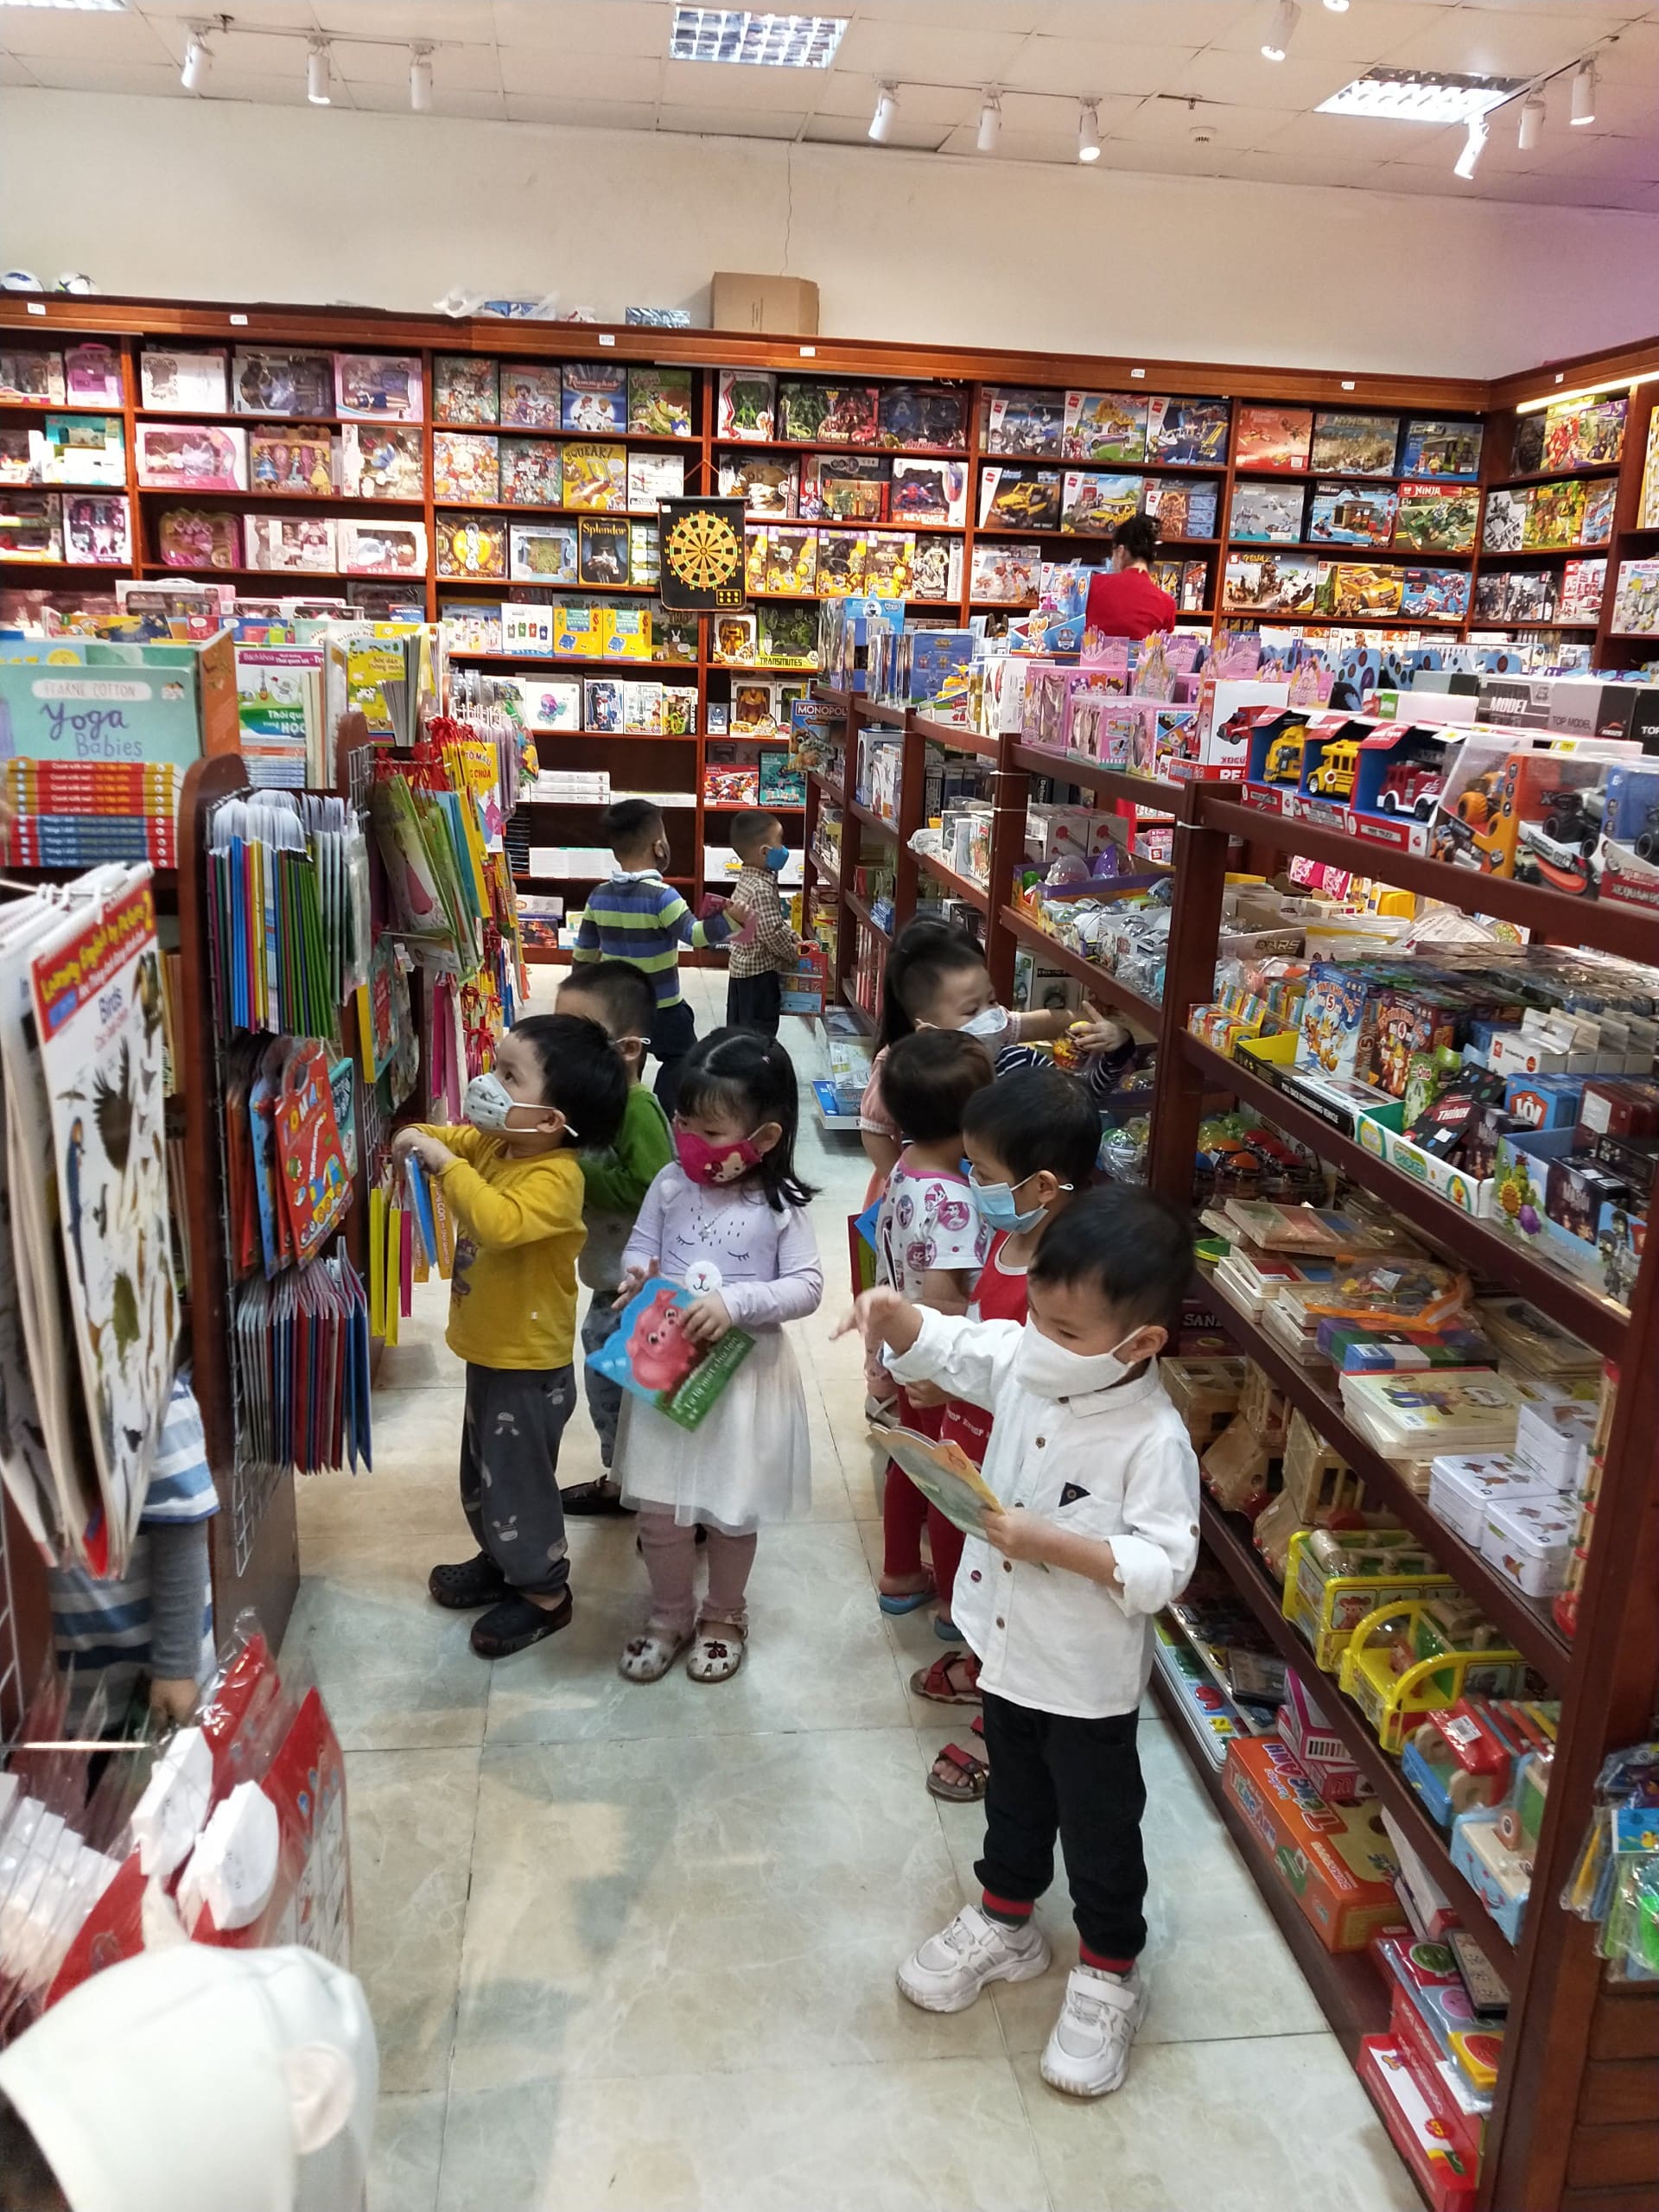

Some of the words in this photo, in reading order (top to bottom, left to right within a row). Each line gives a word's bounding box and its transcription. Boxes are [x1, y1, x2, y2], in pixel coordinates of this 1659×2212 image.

[1414, 486, 1441, 496] NINJA
[582, 522, 627, 537] Splendor
[760, 658, 803, 667] TRANSMUTES
[1491, 696, 1528, 713] MODEL
[41, 702, 129, 741] Yoga
[1554, 716, 1568, 726] TOP
[75, 732, 143, 757] Babies
[1325, 995, 1335, 1010] 5
